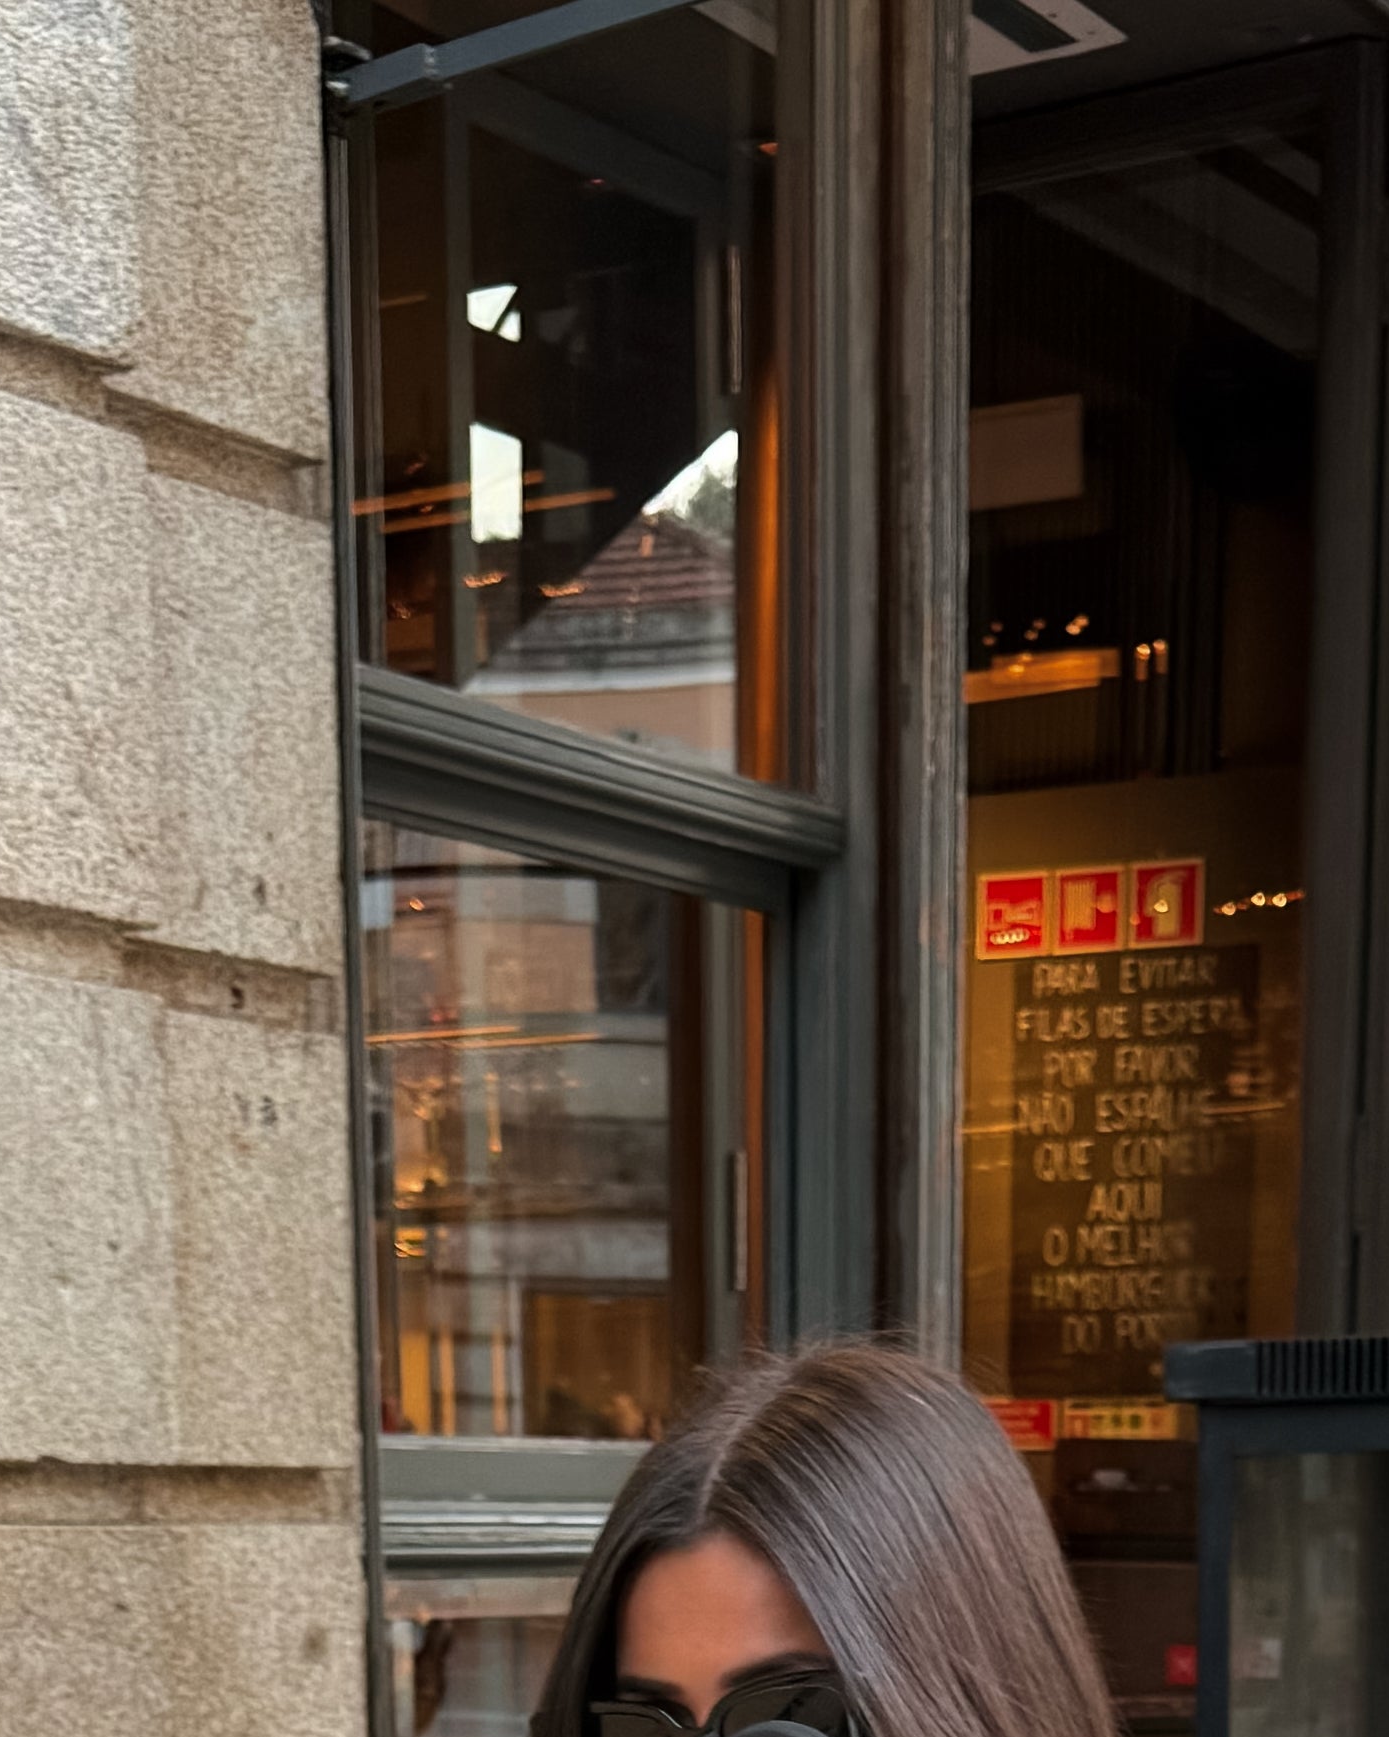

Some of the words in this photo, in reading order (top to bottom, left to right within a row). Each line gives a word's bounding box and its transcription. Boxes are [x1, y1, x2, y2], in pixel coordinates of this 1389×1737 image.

[1032, 962, 1101, 997] PARA
[1118, 956, 1218, 994] EVITAR
[1015, 1007, 1091, 1042] FILAS
[1095, 1005, 1129, 1039] DE
[1042, 1048, 1097, 1087] POR
[1114, 1045, 1199, 1084] FAVOR
[1016, 1091, 1075, 1135] NÃO
[1032, 1141, 1095, 1182] QUE
[1086, 1182, 1163, 1223] AQUI
[1042, 1226, 1069, 1267] O
[1063, 1314, 1102, 1354] DO
